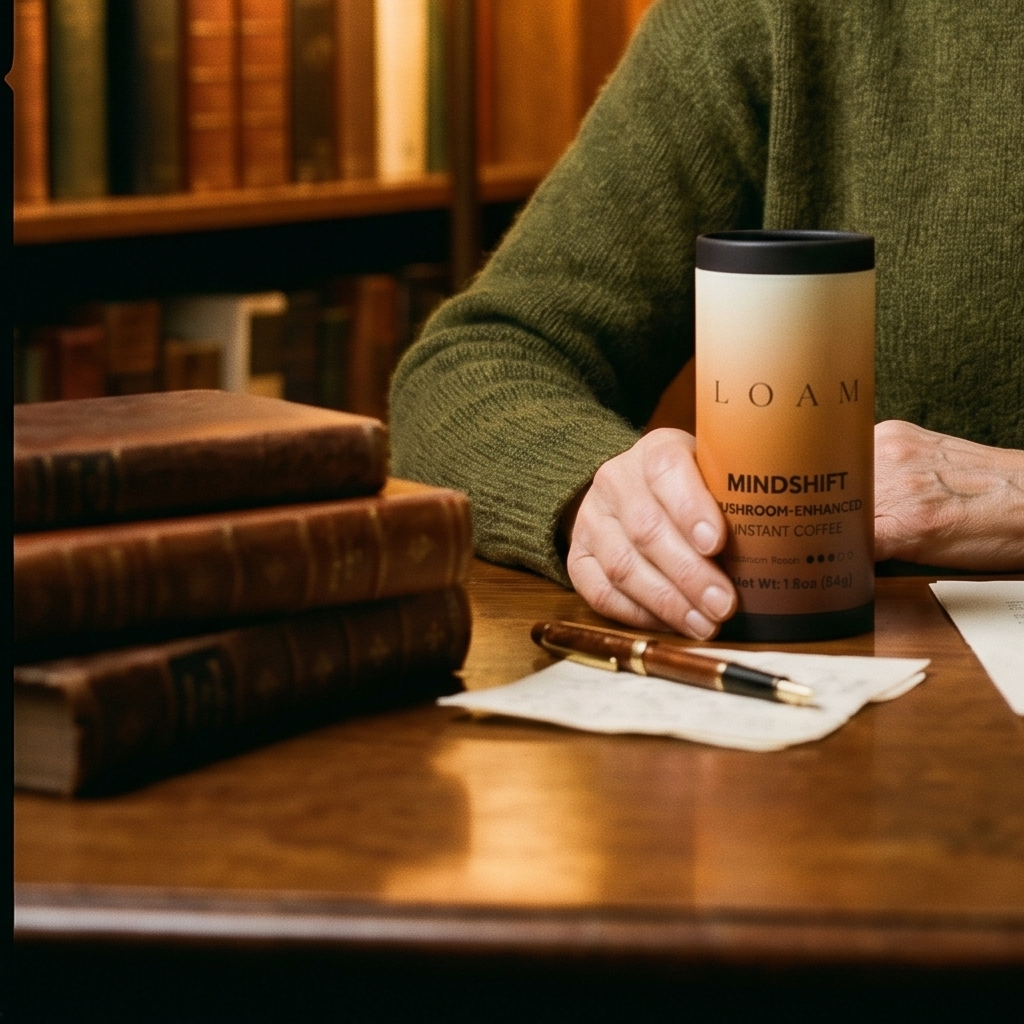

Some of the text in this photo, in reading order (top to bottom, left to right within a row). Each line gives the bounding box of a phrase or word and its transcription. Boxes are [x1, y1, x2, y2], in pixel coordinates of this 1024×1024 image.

[715, 379, 859, 407] LOAM
[728, 472, 848, 494] MINDSHIFT
[718, 499, 862, 517] USHROOM-ENHANCED
[734, 522, 843, 537] INSTANT COFFEE
